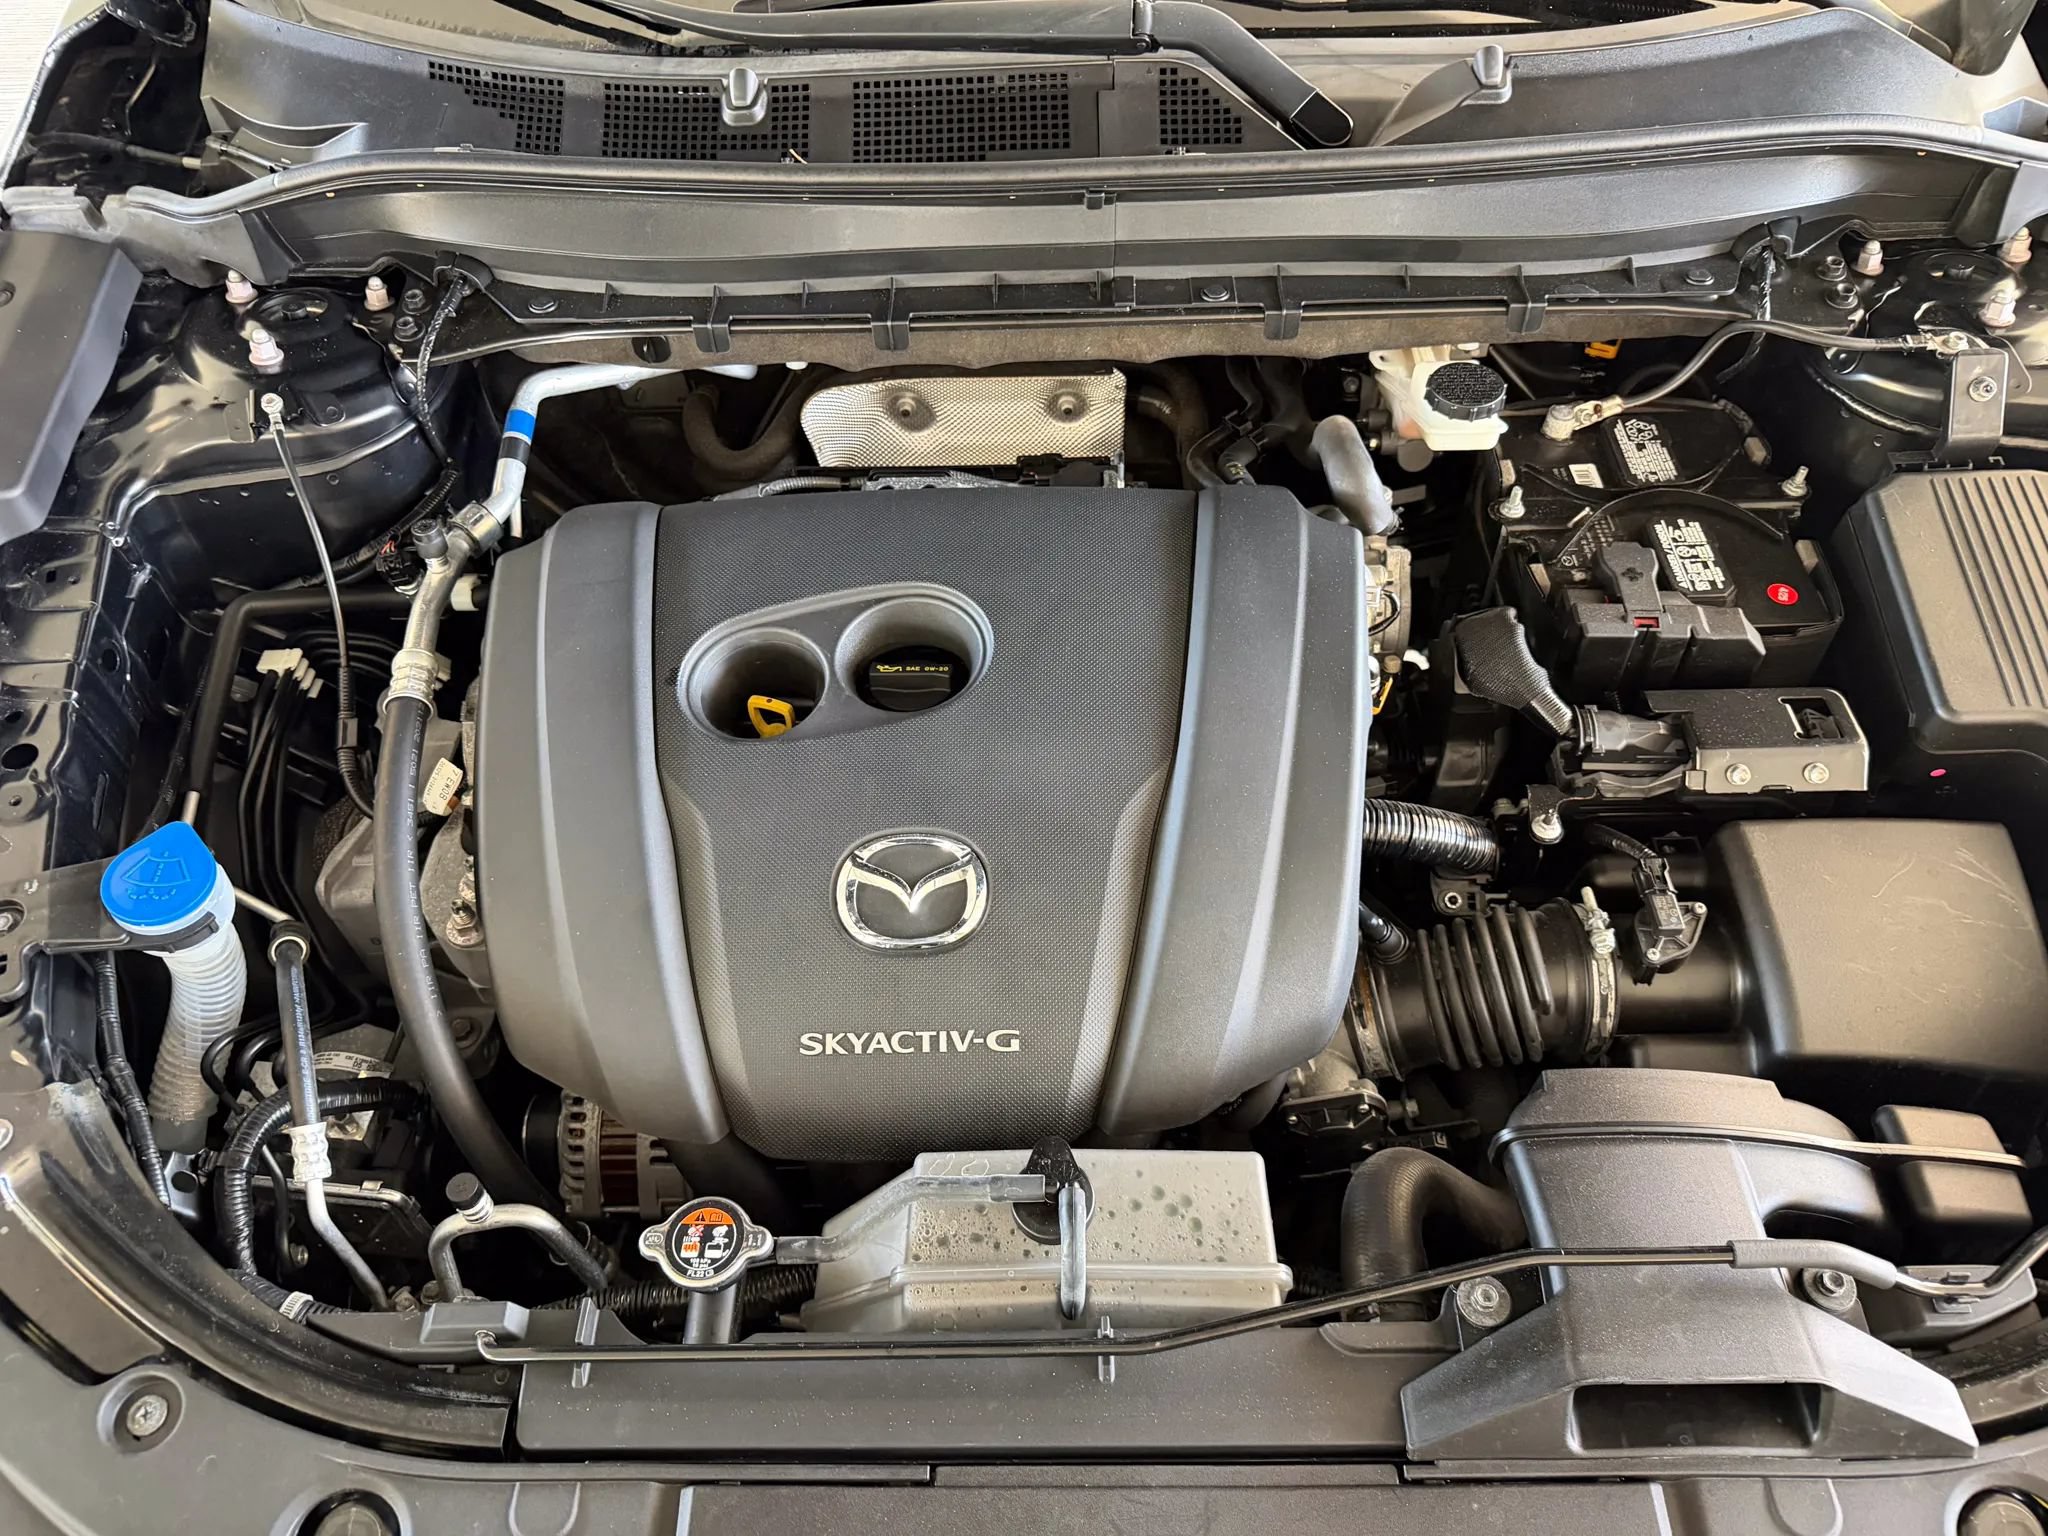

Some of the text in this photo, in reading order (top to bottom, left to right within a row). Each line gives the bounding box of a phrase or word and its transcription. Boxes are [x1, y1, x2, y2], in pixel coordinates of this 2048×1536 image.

[408, 881, 418, 908] PET
[799, 1029, 1020, 1055] SKYACTIV-G
[747, 1234, 762, 1248] 1.1
[686, 1269, 705, 1277] FL22
